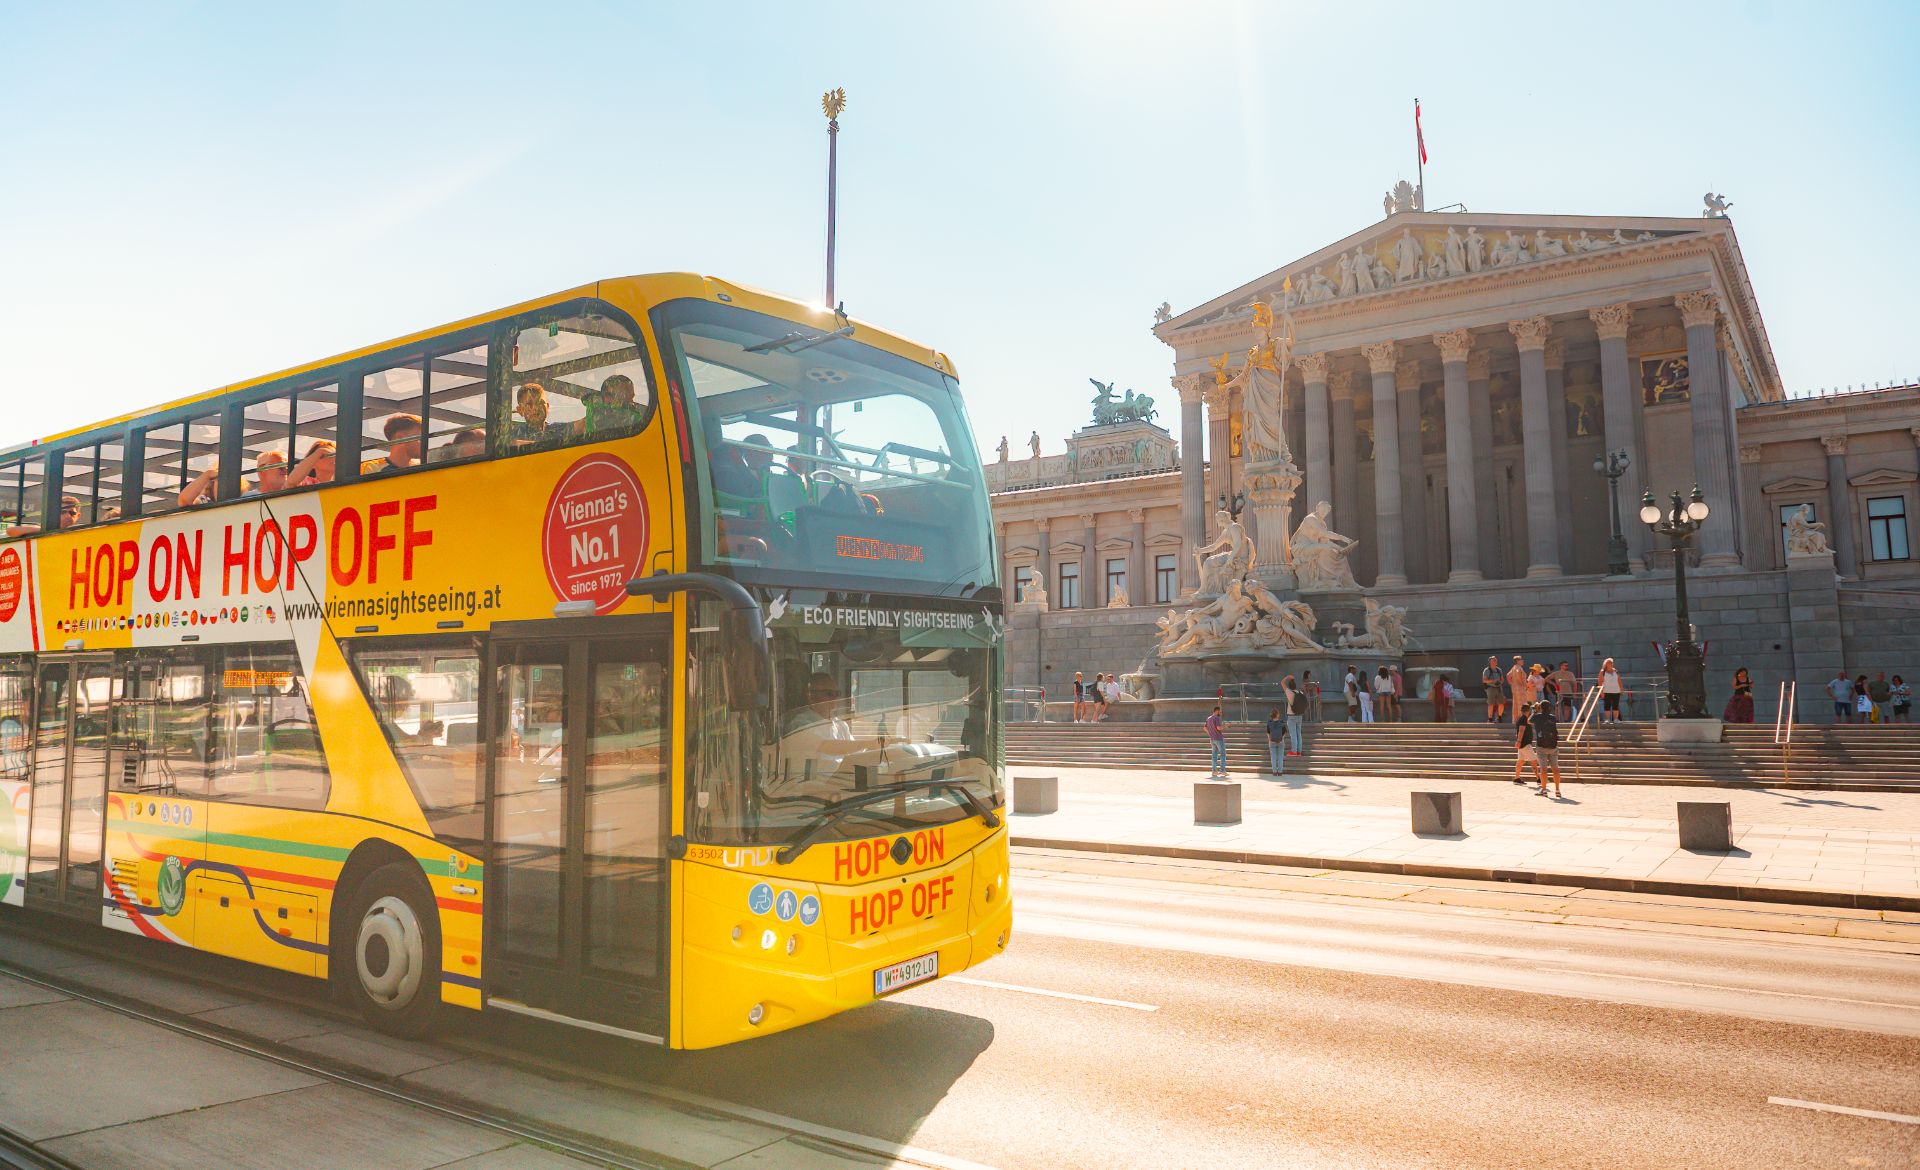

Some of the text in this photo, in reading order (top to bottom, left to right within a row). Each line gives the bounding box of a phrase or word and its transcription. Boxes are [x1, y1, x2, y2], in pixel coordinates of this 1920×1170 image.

[560, 489, 628, 524] Vienna's
[69, 494, 437, 610] HOP ON HOP OFF
[570, 524, 619, 568] No.1
[571, 572, 623, 596] since 1972
[285, 585, 501, 622] www.viennasightseeing.at
[804, 607, 974, 629] ECO FRIENDLY SIGHTSEEING
[690, 847, 723, 859] 63502
[834, 828, 944, 881] HOP ON
[850, 875, 955, 935] HOP OFF
